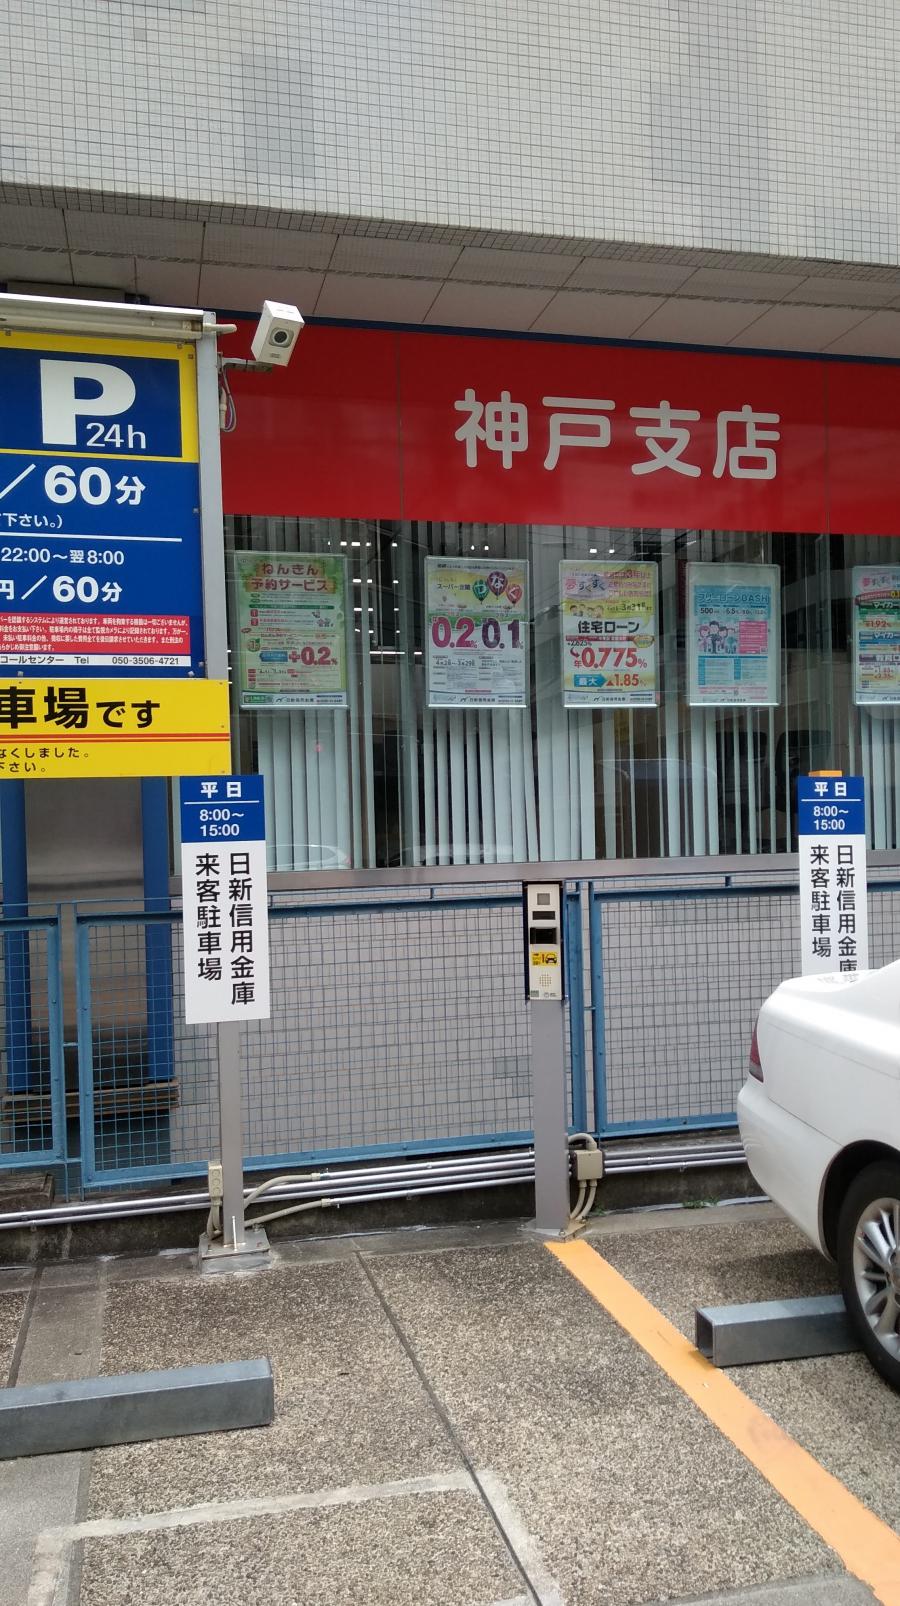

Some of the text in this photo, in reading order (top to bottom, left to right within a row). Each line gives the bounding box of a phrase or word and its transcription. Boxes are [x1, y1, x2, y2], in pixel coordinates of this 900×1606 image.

[40, 358, 137, 446] P
[86, 421, 147, 449] 24h
[454, 388, 780, 480] 神戸支店
[262, 562, 319, 576] ねんきん
[251, 578, 328, 592] 予約サービス
[578, 620, 640, 634] 住宅ローン
[0, 656, 179, 665] コールセンター Tel 050-3506-4721
[0, 686, 161, 729] 車場です
[200, 781, 242, 799] 平日
[814, 781, 847, 797] 平日
[200, 823, 240, 837] 15:00
[814, 819, 845, 831] 15:00
[810, 844, 832, 958] 来客駐車場
[195, 852, 223, 982] 来客駐車場
[229, 852, 256, 1006] 日新信用金庫
